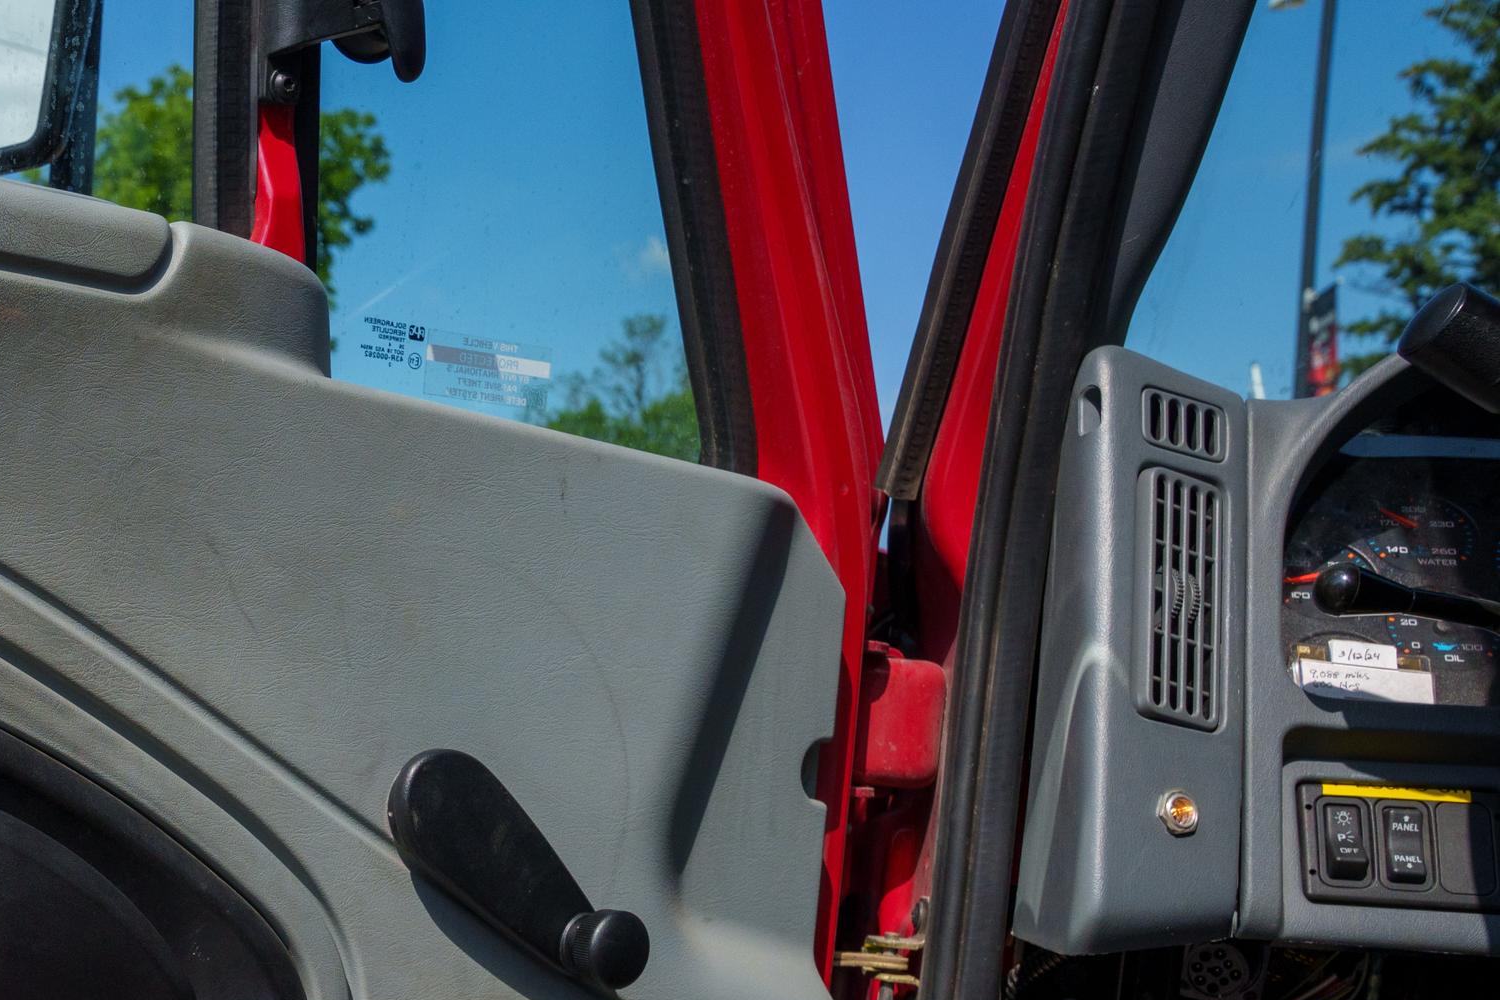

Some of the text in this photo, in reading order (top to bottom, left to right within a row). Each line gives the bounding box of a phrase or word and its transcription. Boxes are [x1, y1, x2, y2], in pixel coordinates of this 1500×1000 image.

[1418, 558, 1458, 566] WATER
[1444, 654, 1465, 662] OIL
[1392, 823, 1420, 832] PANEL
[1394, 855, 1422, 863] PANEL
